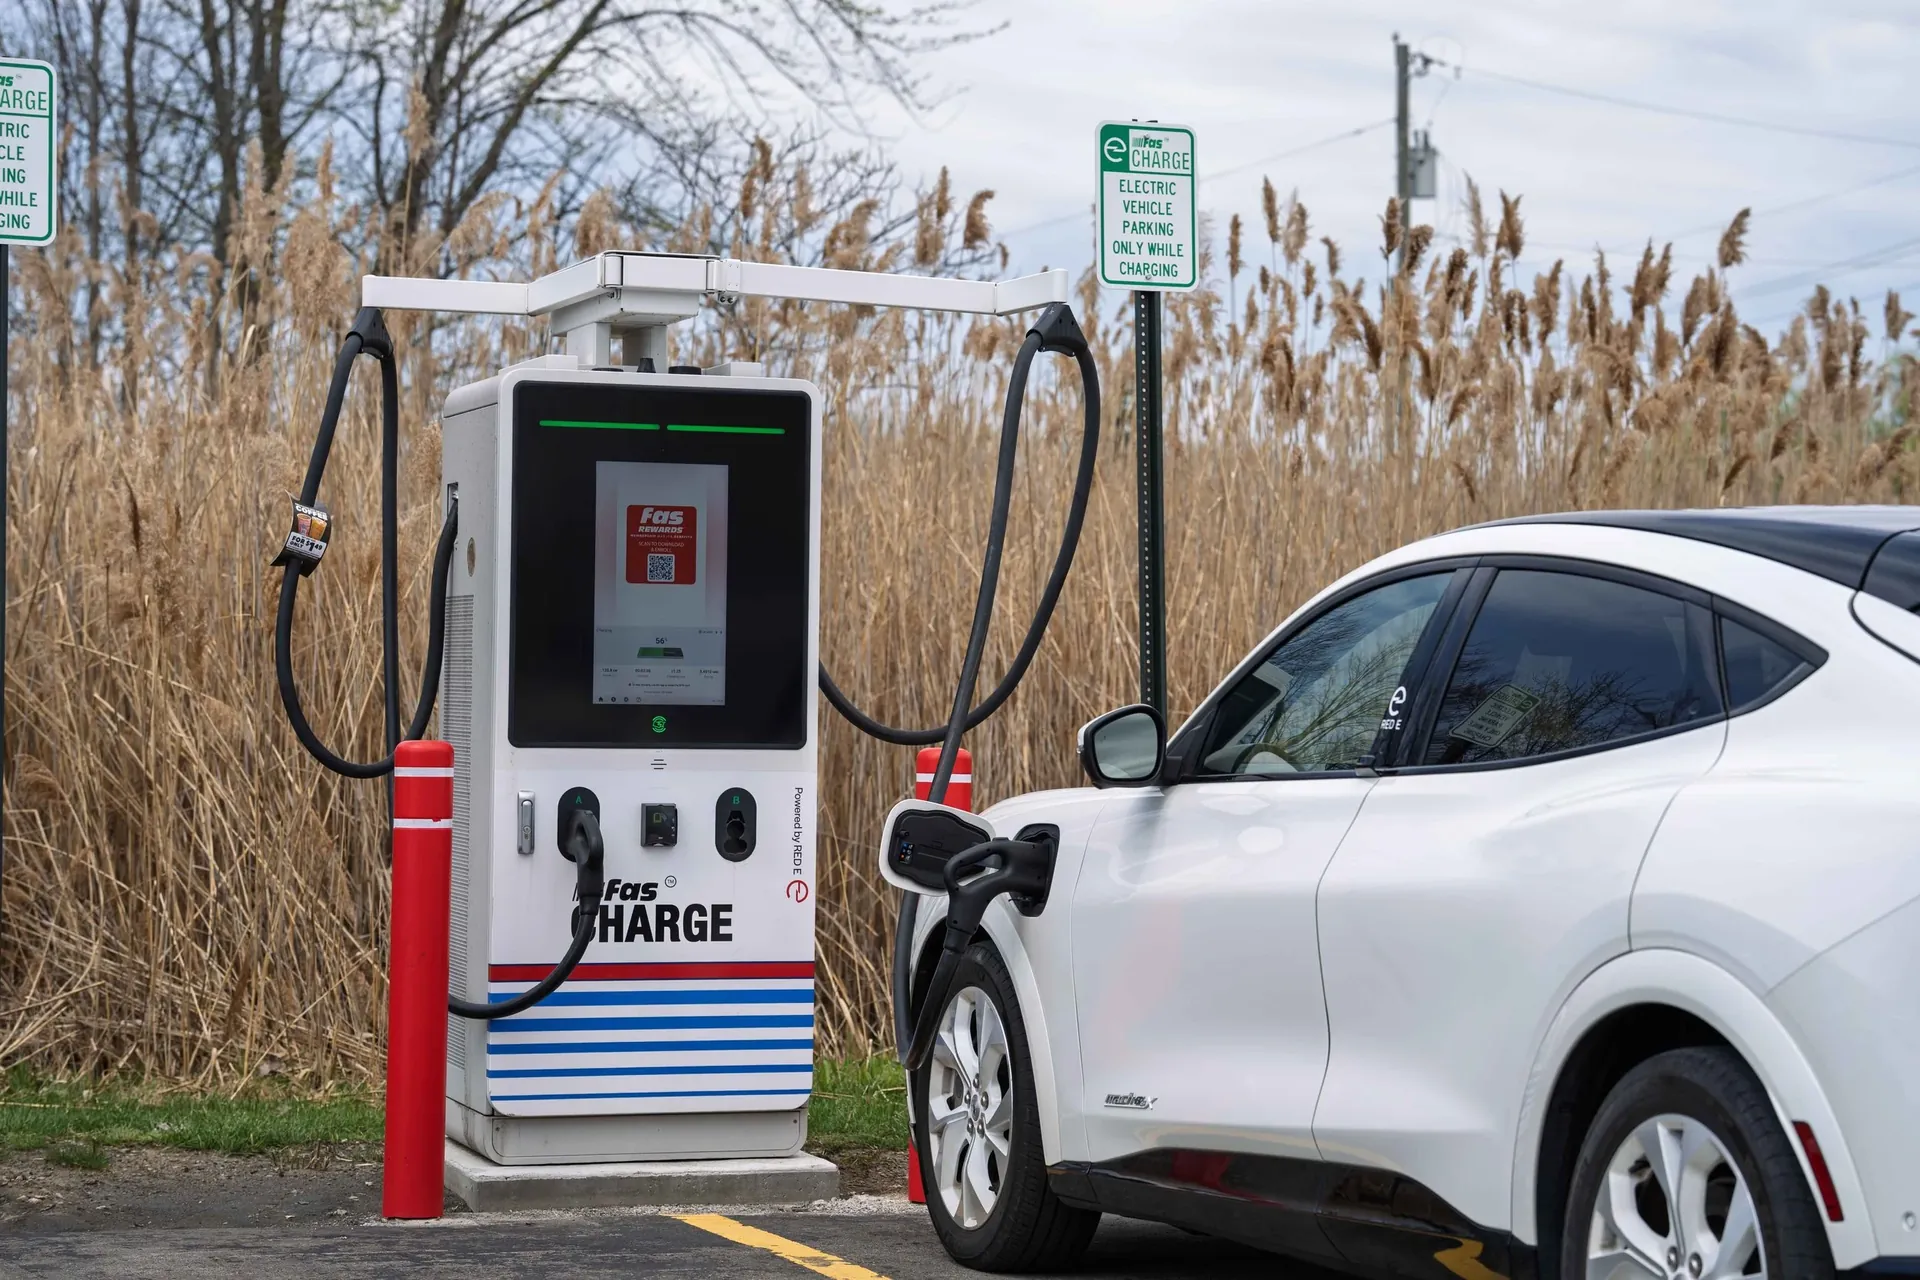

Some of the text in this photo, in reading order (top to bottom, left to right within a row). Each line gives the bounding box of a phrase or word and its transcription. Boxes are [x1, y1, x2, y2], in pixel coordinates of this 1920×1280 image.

[1132, 149, 1190, 170] CHARGE
[1119, 179, 1176, 195] ELECTRIC
[1123, 200, 1172, 216] VEHICLE
[1122, 221, 1174, 236] PARKING
[1112, 240, 1184, 257] ONLY WHILE
[1119, 261, 1178, 278] CHARGING
[295, 505, 328, 520] COFFEE
[638, 526, 684, 534] REWARDS
[291, 535, 306, 545] FOR
[1380, 719, 1403, 731] RED E
[575, 795, 583, 804] A
[732, 796, 740, 804] B
[793, 787, 803, 829] Powered
[791, 831, 803, 844] by
[793, 845, 803, 867] RED
[571, 903, 733, 943] CHARGE
